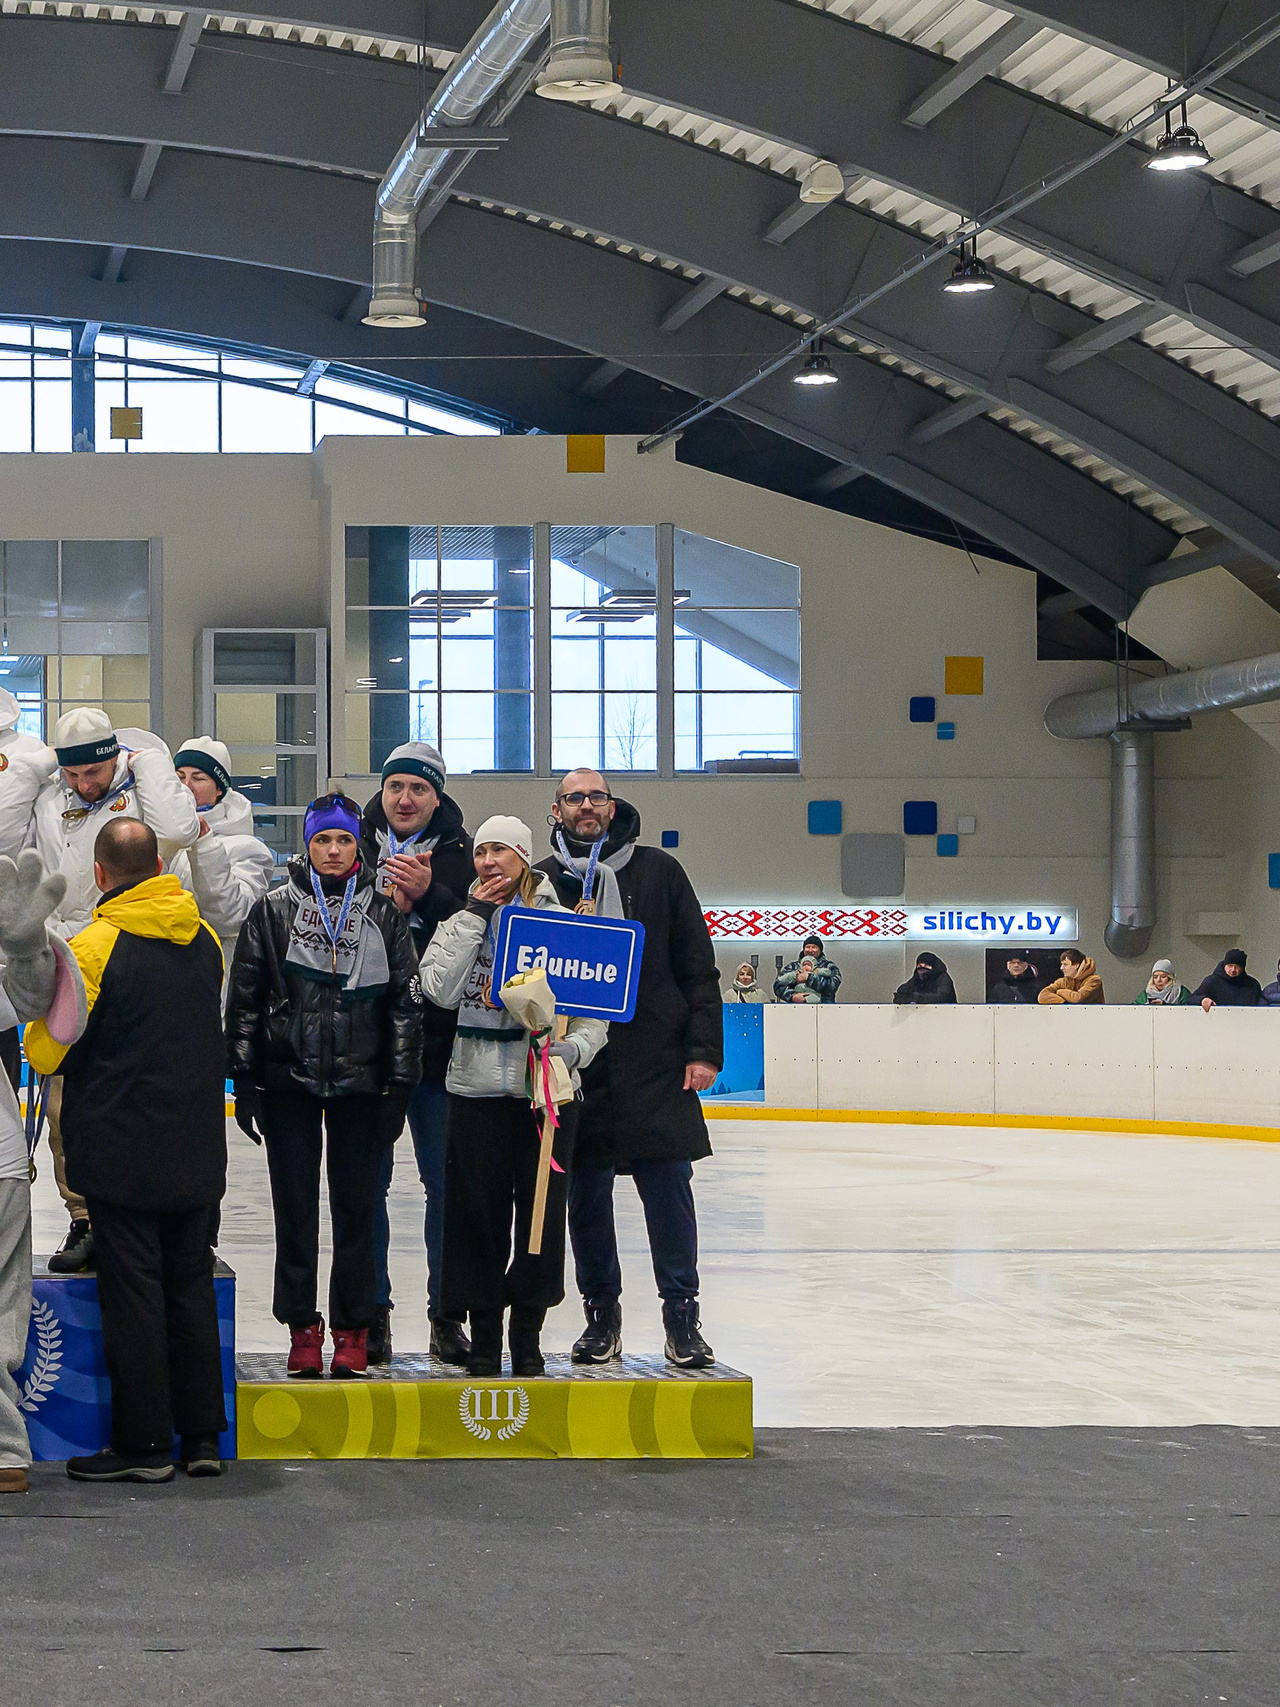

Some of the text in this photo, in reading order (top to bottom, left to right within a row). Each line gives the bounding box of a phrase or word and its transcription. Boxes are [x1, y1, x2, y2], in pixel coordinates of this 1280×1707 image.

[923, 911, 1062, 935] silichy.by
[516, 945, 618, 983] Единые
[471, 1389, 519, 1420] III
